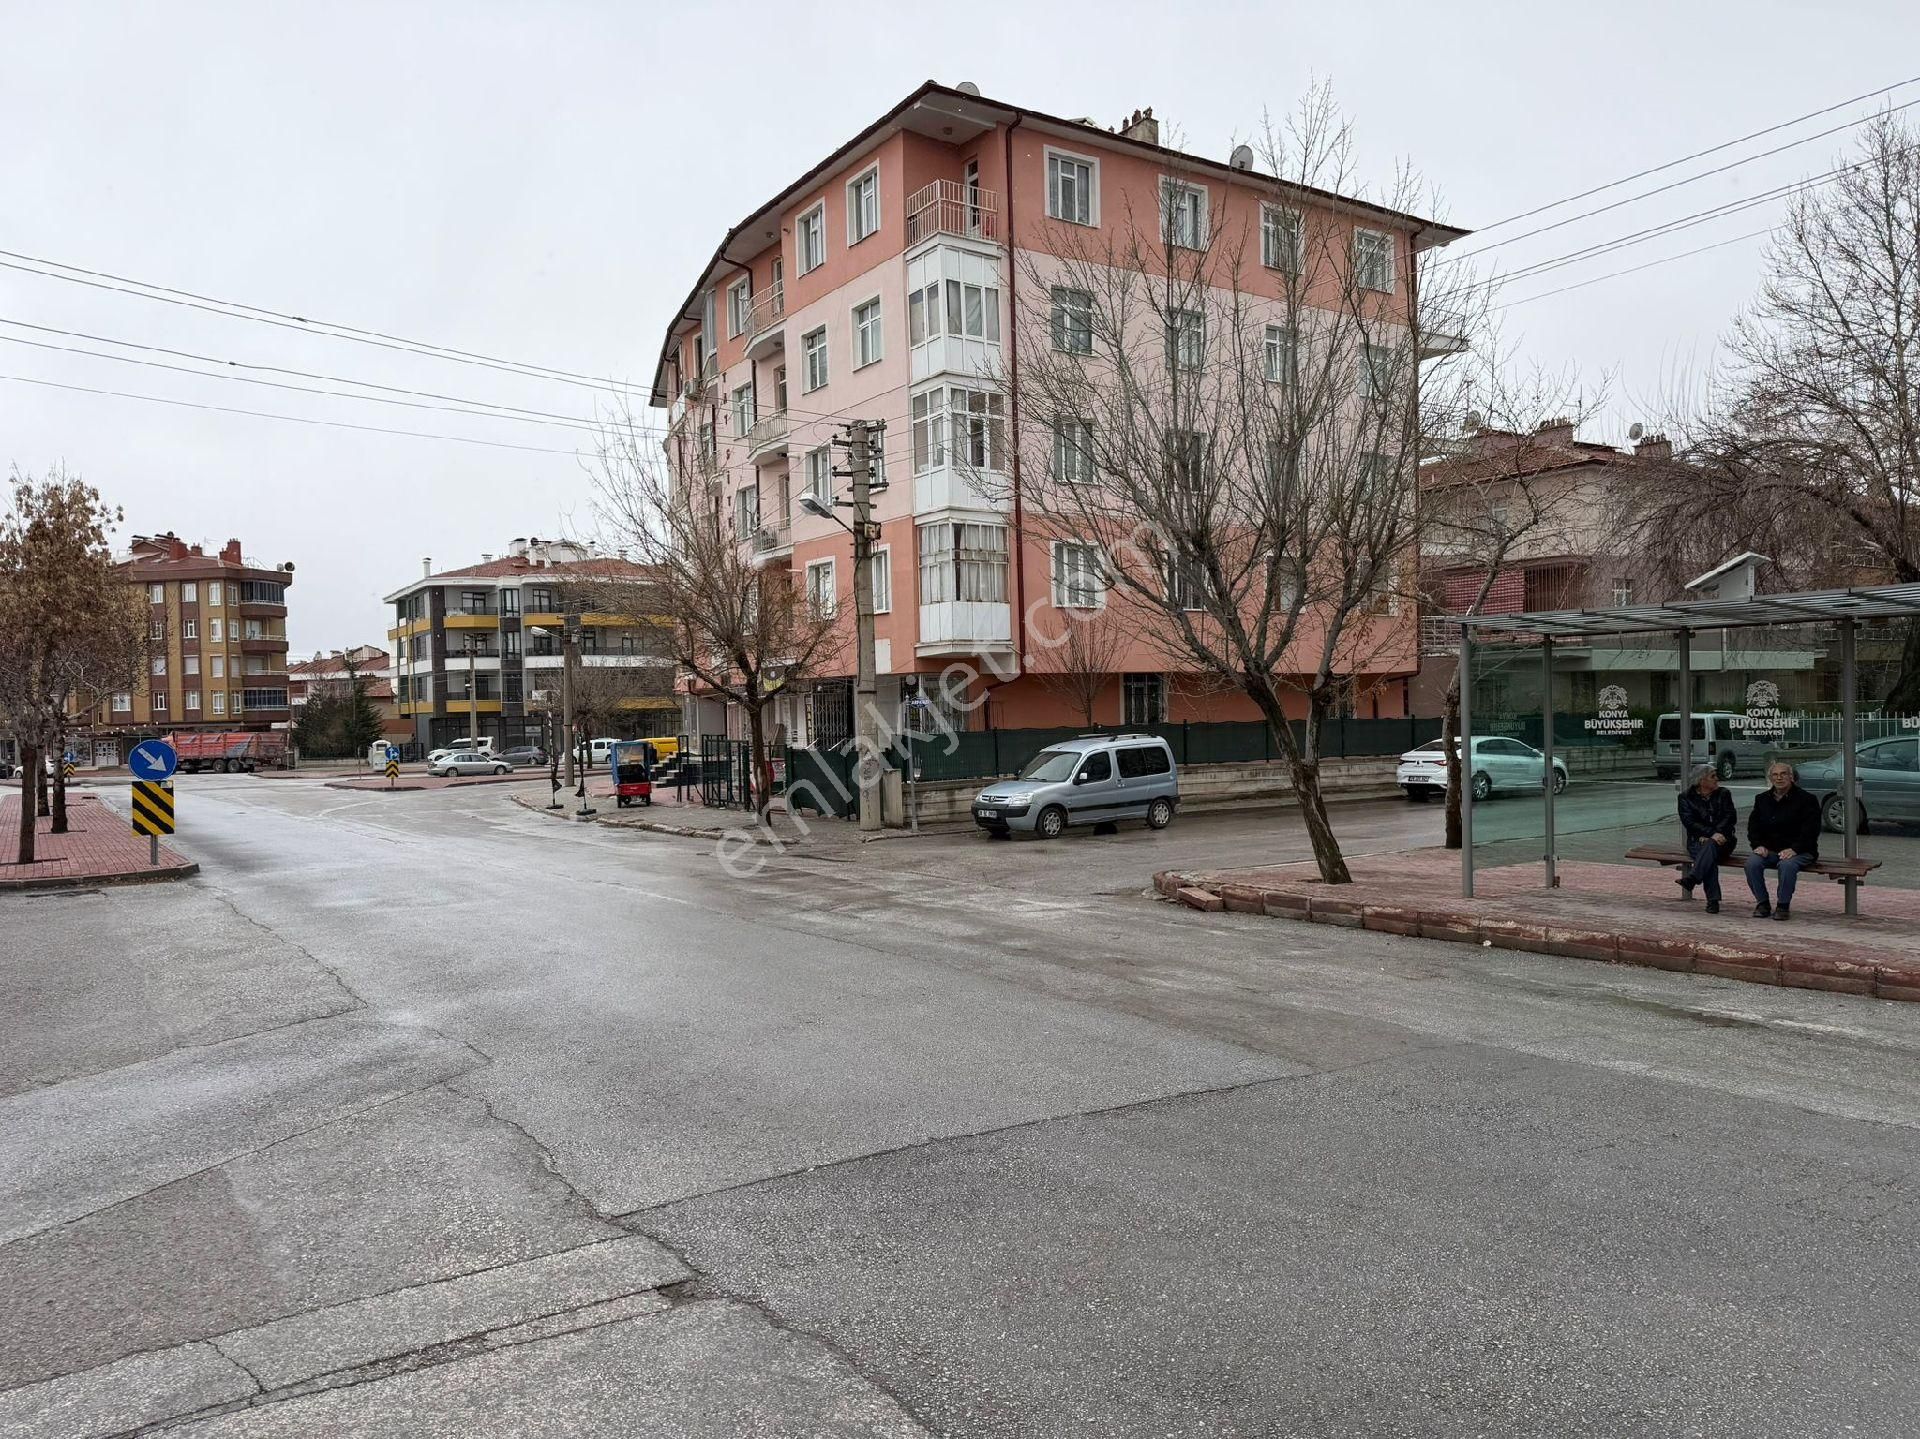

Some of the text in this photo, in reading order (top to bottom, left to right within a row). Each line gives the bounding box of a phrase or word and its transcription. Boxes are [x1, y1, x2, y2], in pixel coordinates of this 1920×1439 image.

[1598, 710, 1629, 719] KONYA
[1746, 707, 1781, 719] KONYA
[1584, 718, 1644, 730] BÜYÜKŞEHİR
[1729, 717, 1800, 729] BÜYÜKŞEHİR
